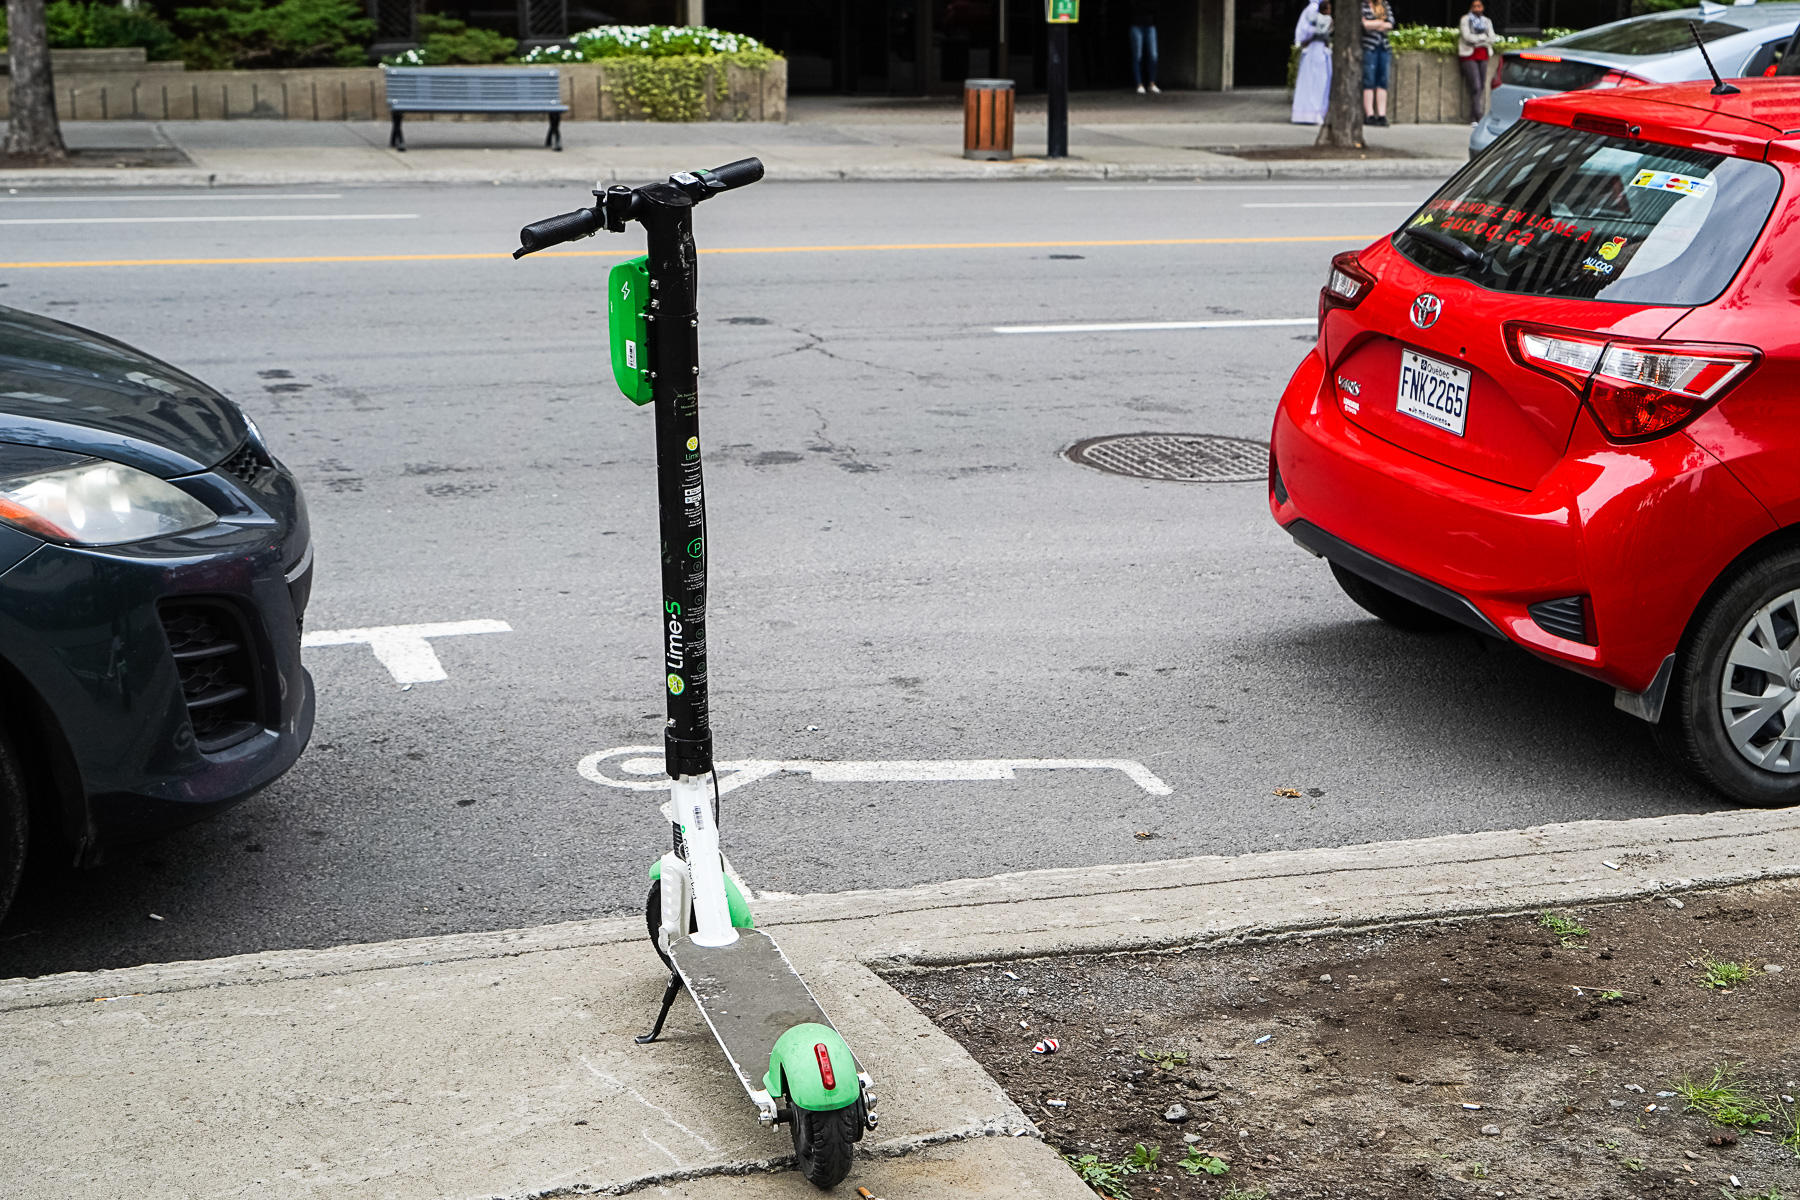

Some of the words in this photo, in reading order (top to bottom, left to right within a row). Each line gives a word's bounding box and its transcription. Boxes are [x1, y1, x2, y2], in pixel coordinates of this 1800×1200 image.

[1441, 216, 1535, 247] aucoq.ca
[1503, 209, 1526, 223] EN
[1526, 214, 1577, 237] LIGNE
[1427, 362, 1450, 379] Québec
[1401, 366, 1465, 418] FNK2265
